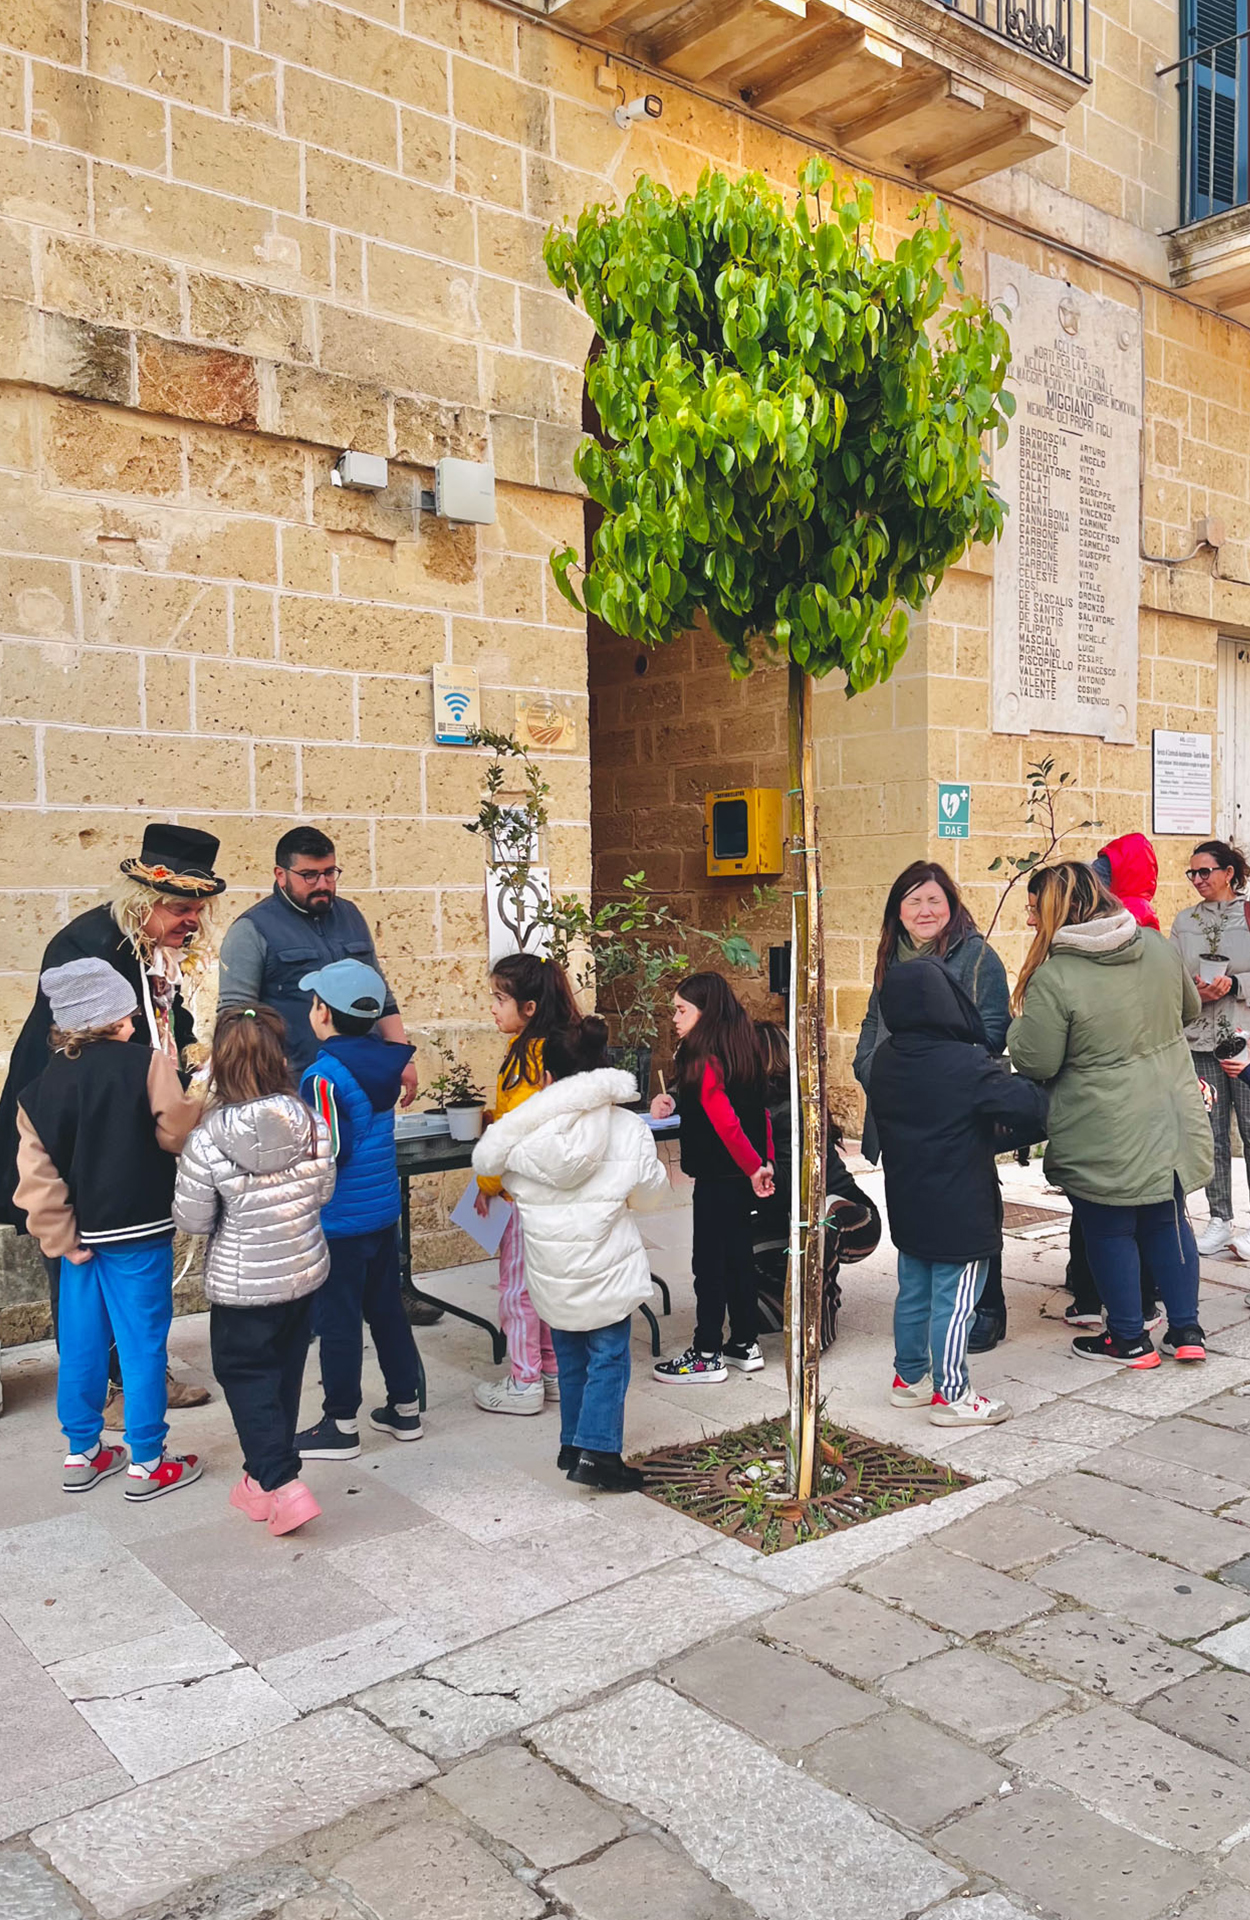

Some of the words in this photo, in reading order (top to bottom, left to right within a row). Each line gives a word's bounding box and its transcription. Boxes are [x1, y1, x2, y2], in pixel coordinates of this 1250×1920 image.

[1024, 355, 1047, 374] NELLA
[1050, 364, 1076, 383] GUERRA
[1034, 344, 1054, 362] MORTI
[1056, 352, 1070, 367] PER
[1072, 357, 1080, 372] LA
[1017, 366, 1042, 386] MAGGIO
[1076, 384, 1110, 408] NOVEMBRE
[1046, 390, 1094, 419] MIGGIANO
[1026, 401, 1054, 421] MEMORE
[1056, 410, 1068, 425] DEI
[1070, 414, 1094, 433] PROPRI
[1096, 422, 1113, 438] FIGLI
[1020, 424, 1067, 448] BARDOSCIA
[1080, 444, 1106, 458] ARTURO
[1020, 436, 1058, 455] BRAMATO
[1080, 454, 1106, 468] ANGELO
[1020, 447, 1058, 466] BRAMATO
[1080, 464, 1094, 476] VITO
[1020, 458, 1072, 480] CACCIATORE
[1080, 475, 1100, 488] PAOLO
[1020, 469, 1050, 486] CALATI
[1080, 486, 1112, 502] GIUSEPPE
[1020, 480, 1050, 496] CALATI
[1080, 496, 1116, 513] SALVATORE
[1020, 491, 1050, 507] CALATI
[1080, 508, 1112, 522] VINCENZO
[1020, 502, 1070, 522] CANNABONA
[1080, 517, 1108, 532] CARMINE
[1020, 513, 1070, 533] CANNABONA
[1080, 528, 1120, 544] CROCEFISSO
[1020, 524, 1059, 541] CARBONE
[1080, 538, 1110, 552] CARMELO
[1020, 535, 1059, 552] CARBONE
[1079, 549, 1111, 563] GIUSEPPE
[1020, 546, 1058, 562] CARBONE
[1079, 560, 1099, 571] MARIO
[1019, 556, 1058, 573] CARBONE
[1079, 571, 1094, 580] VITO
[1019, 568, 1058, 584] CELESTE
[1079, 581, 1102, 592] VITALE
[1019, 590, 1030, 600] DE
[1033, 592, 1074, 608] PASCALIS
[1079, 602, 1105, 613] ORONZO
[1079, 591, 1105, 603] ORONZO
[1019, 600, 1030, 610] DE
[1033, 603, 1064, 616] SANTIS
[1078, 612, 1115, 626] SALVATORE
[1019, 611, 1030, 621] DE
[1033, 614, 1064, 627] SANTIS
[1078, 624, 1094, 632] VITO
[1019, 622, 1052, 636] FILIPPO
[1078, 633, 1107, 644] MICHELE
[1019, 633, 1057, 647] MASCIALI
[1078, 644, 1095, 653] LUIGI
[1019, 644, 1060, 658] MORCIANO
[1078, 654, 1104, 665] CESARE
[1019, 654, 1073, 671] PISCOPIELLO
[1078, 664, 1116, 676] FRANCESCO
[1019, 665, 1056, 679] VALENTE
[1078, 675, 1105, 686] ANTONIO
[1019, 676, 1056, 690] VALENTE
[1078, 685, 1101, 695] COSIMO
[1019, 687, 1056, 700] VALENTE
[1078, 695, 1110, 706] DOMENICO
[945, 826, 962, 835] DAE
